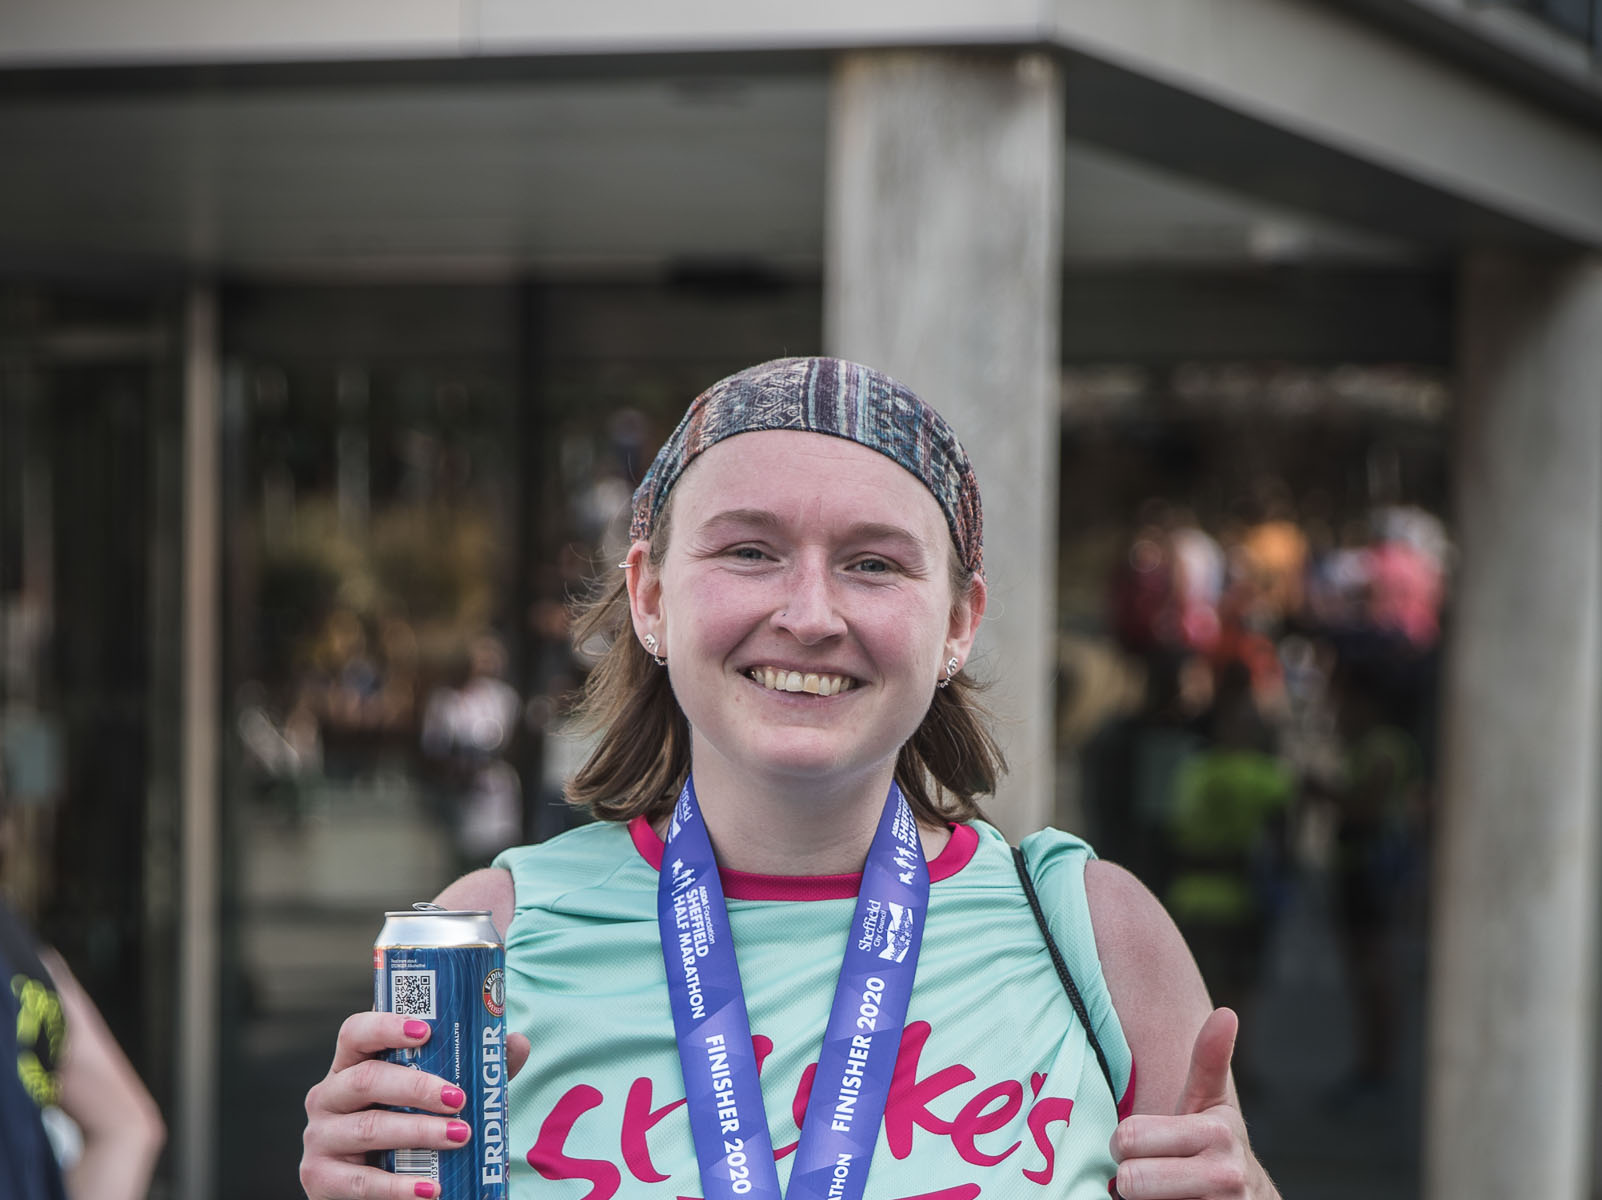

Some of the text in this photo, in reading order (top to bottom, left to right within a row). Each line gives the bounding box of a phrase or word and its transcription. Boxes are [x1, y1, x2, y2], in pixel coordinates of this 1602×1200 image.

[673, 895, 705, 1020] HALF MARATHON
[686, 888, 709, 958] SHEFFIELD
[699, 886, 715, 944] ASDA Foundation
[858, 899, 881, 952] Sheffield
[873, 909, 887, 948] City Council
[831, 977, 885, 1132] FINISHER 2020
[482, 1021, 504, 1186] ERDINGER
[705, 1034, 752, 1195] FINISHER 2020
